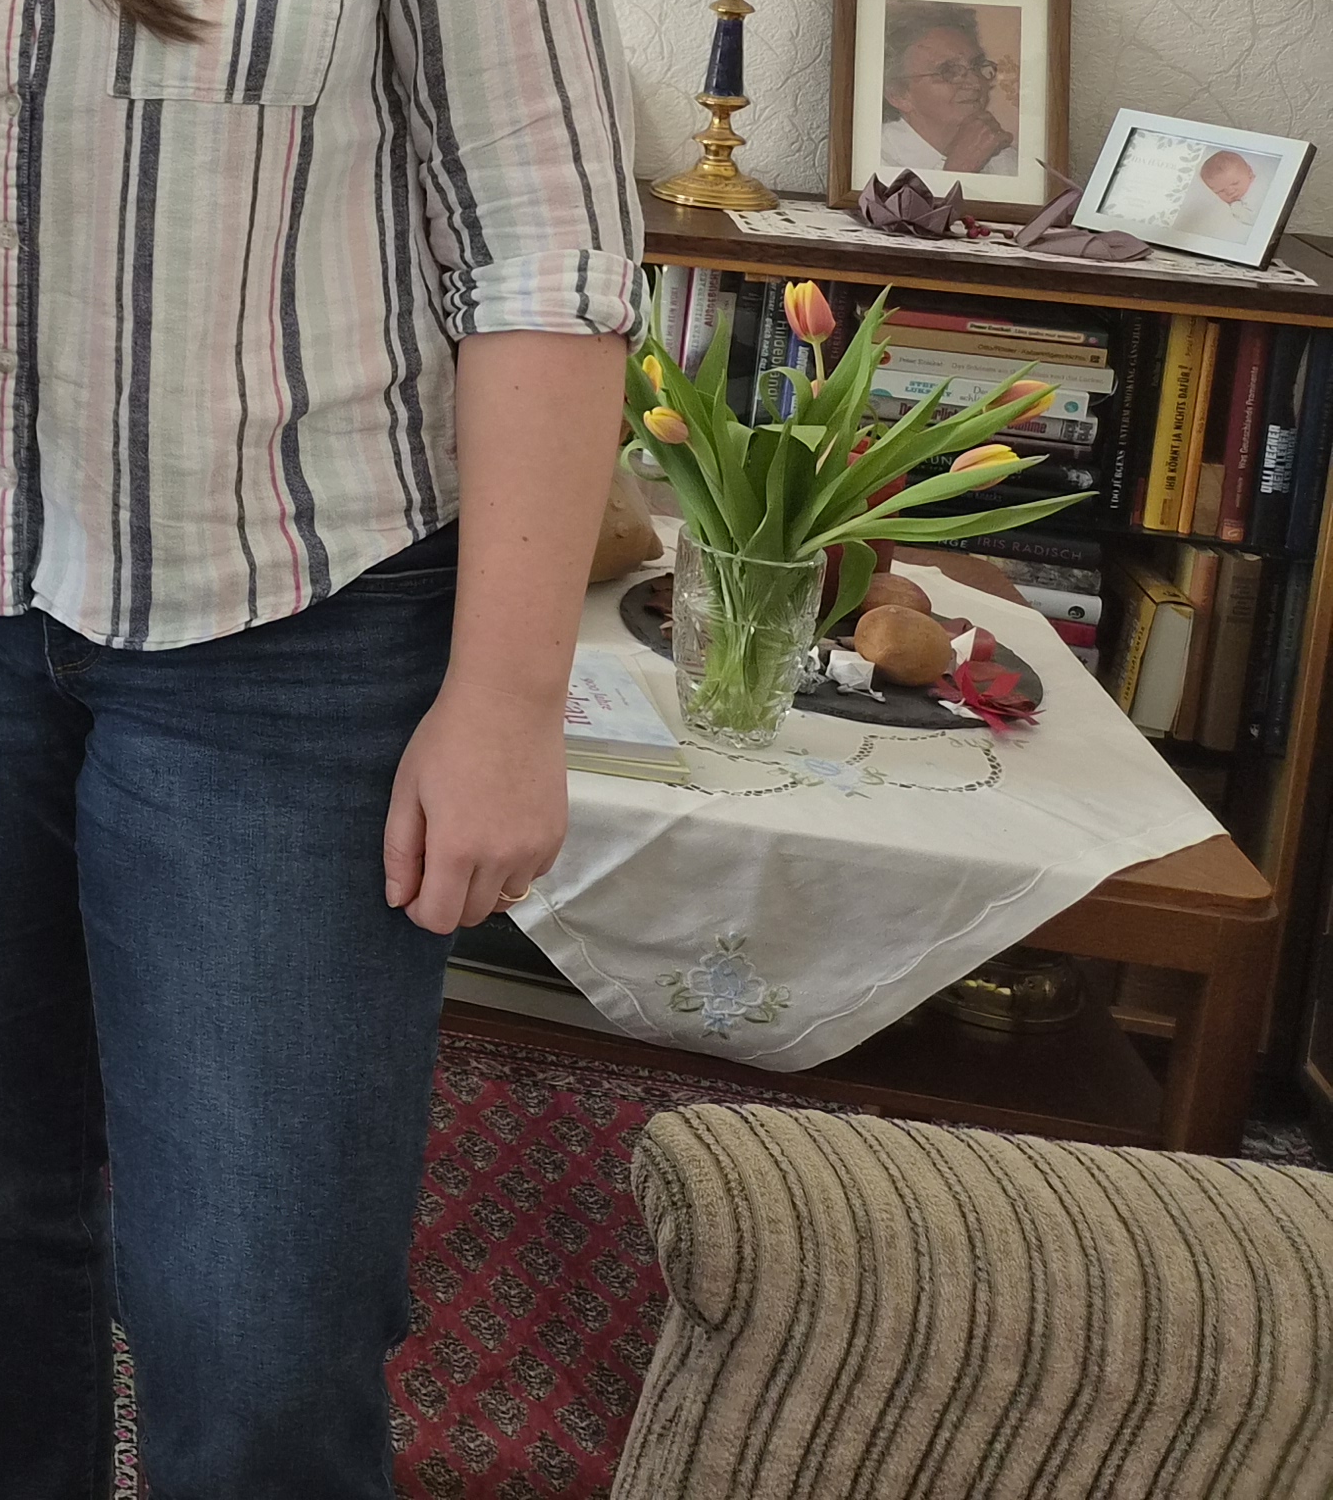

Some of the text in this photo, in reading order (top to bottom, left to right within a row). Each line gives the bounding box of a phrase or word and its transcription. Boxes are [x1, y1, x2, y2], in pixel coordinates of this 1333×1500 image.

[767, 320, 787, 401] Hildebandt
[1172, 402, 1187, 431] NICHTS
[1171, 432, 1183, 443] JA
[1263, 424, 1281, 468] WEGNER
[1165, 445, 1181, 473] KÖNNT
[1164, 475, 1177, 491] IHR
[977, 536, 1006, 550] IRIS
[1012, 541, 1083, 561] RADISCH
